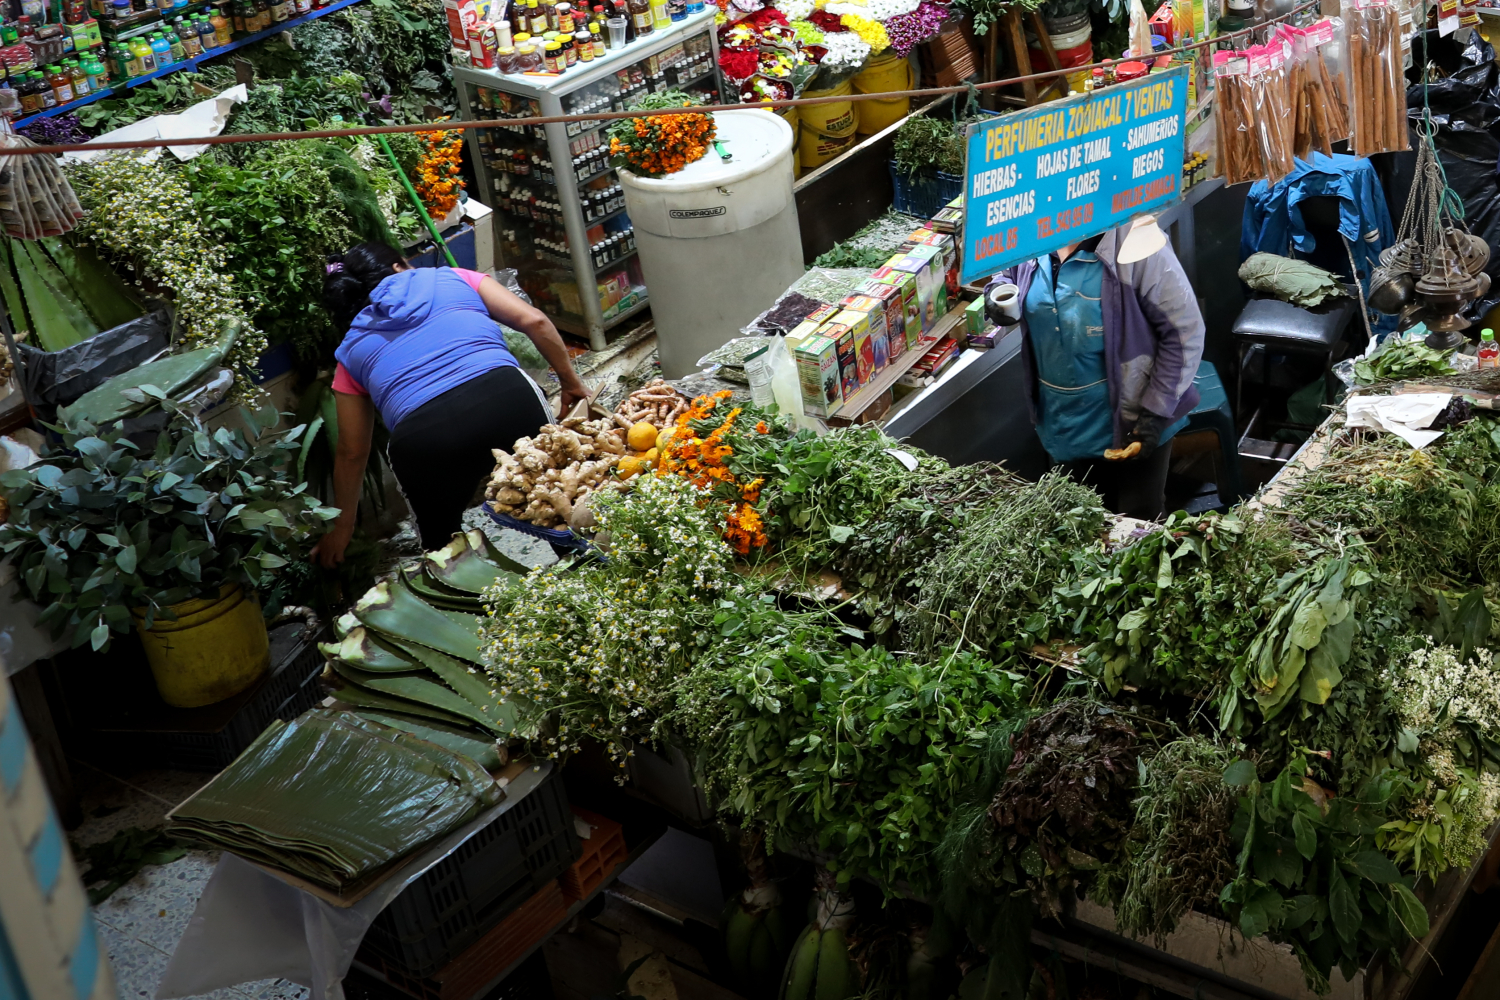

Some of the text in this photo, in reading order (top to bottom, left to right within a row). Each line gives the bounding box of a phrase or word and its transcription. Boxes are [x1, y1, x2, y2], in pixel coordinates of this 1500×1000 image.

[986, 110, 1064, 162] PERFUMERIA
[1067, 95, 1122, 139] ZODIACAL
[1133, 80, 1173, 119] VENTAS
[986, 148, 1165, 227] ESENCIAS FLORES RIEGOS
[1036, 148, 1068, 179] HOJAS
[1069, 145, 1083, 170] DE
[1084, 137, 1111, 165] TAMAL
[671, 207, 724, 218] COLEMPAQUES
[975, 232, 1004, 261] LOCAL
[1006, 227, 1018, 250] 85
[1037, 213, 1055, 239] TEL.
[1056, 210, 1071, 234] 543
[1071, 206, 1082, 227] 95
[1111, 185, 1143, 214] MATILDE
[1144, 174, 1175, 205] SAMACA
[820, 355, 837, 373] RAIZAN
